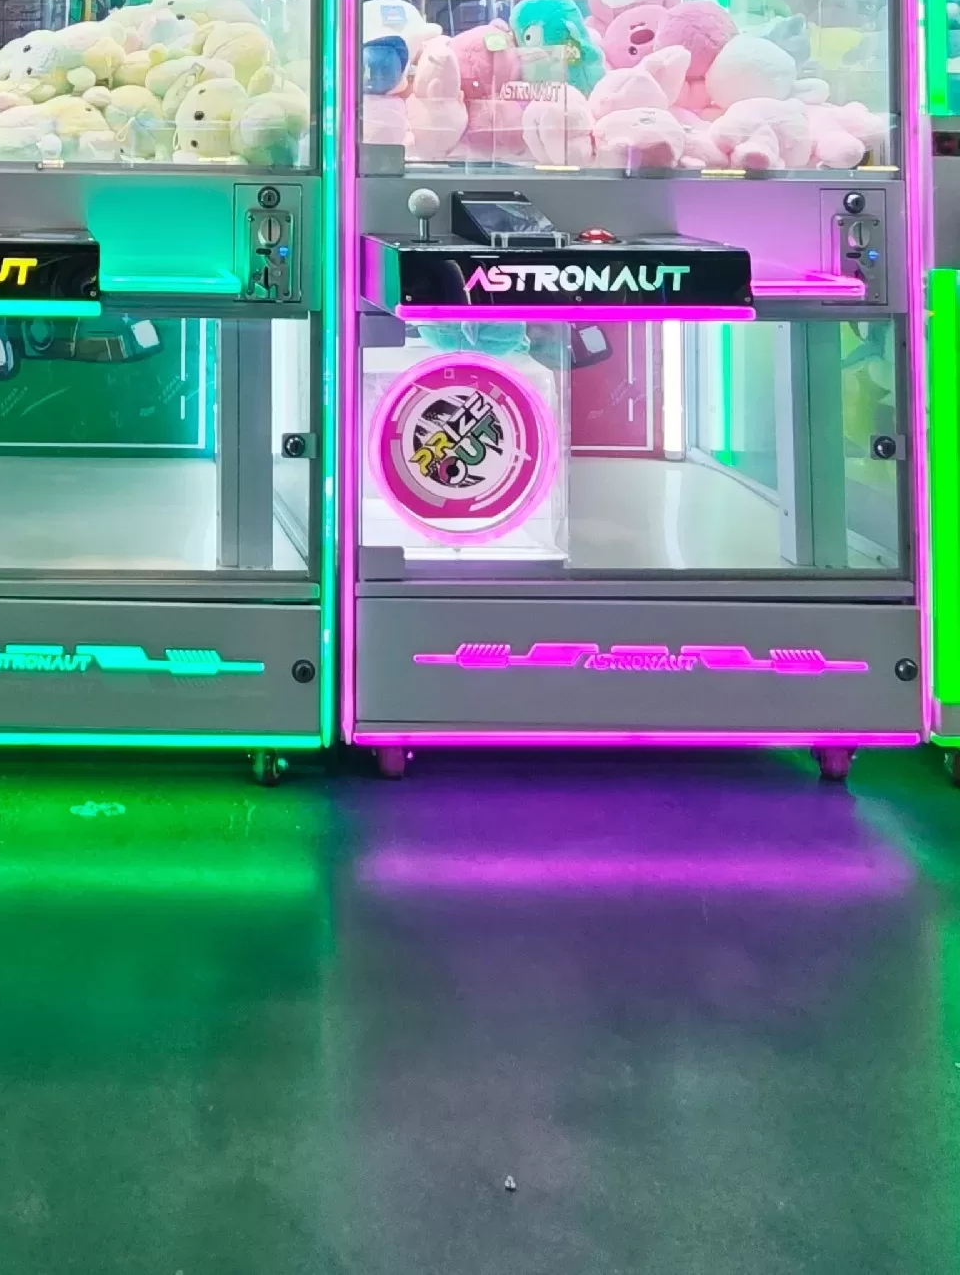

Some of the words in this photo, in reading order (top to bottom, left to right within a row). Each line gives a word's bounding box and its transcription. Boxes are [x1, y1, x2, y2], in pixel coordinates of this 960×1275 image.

[463, 265, 691, 292] ASTRONAUT
[408, 390, 493, 477] PRIZE
[438, 411, 499, 485] OUT
[583, 653, 698, 671] ASTRONAUT
